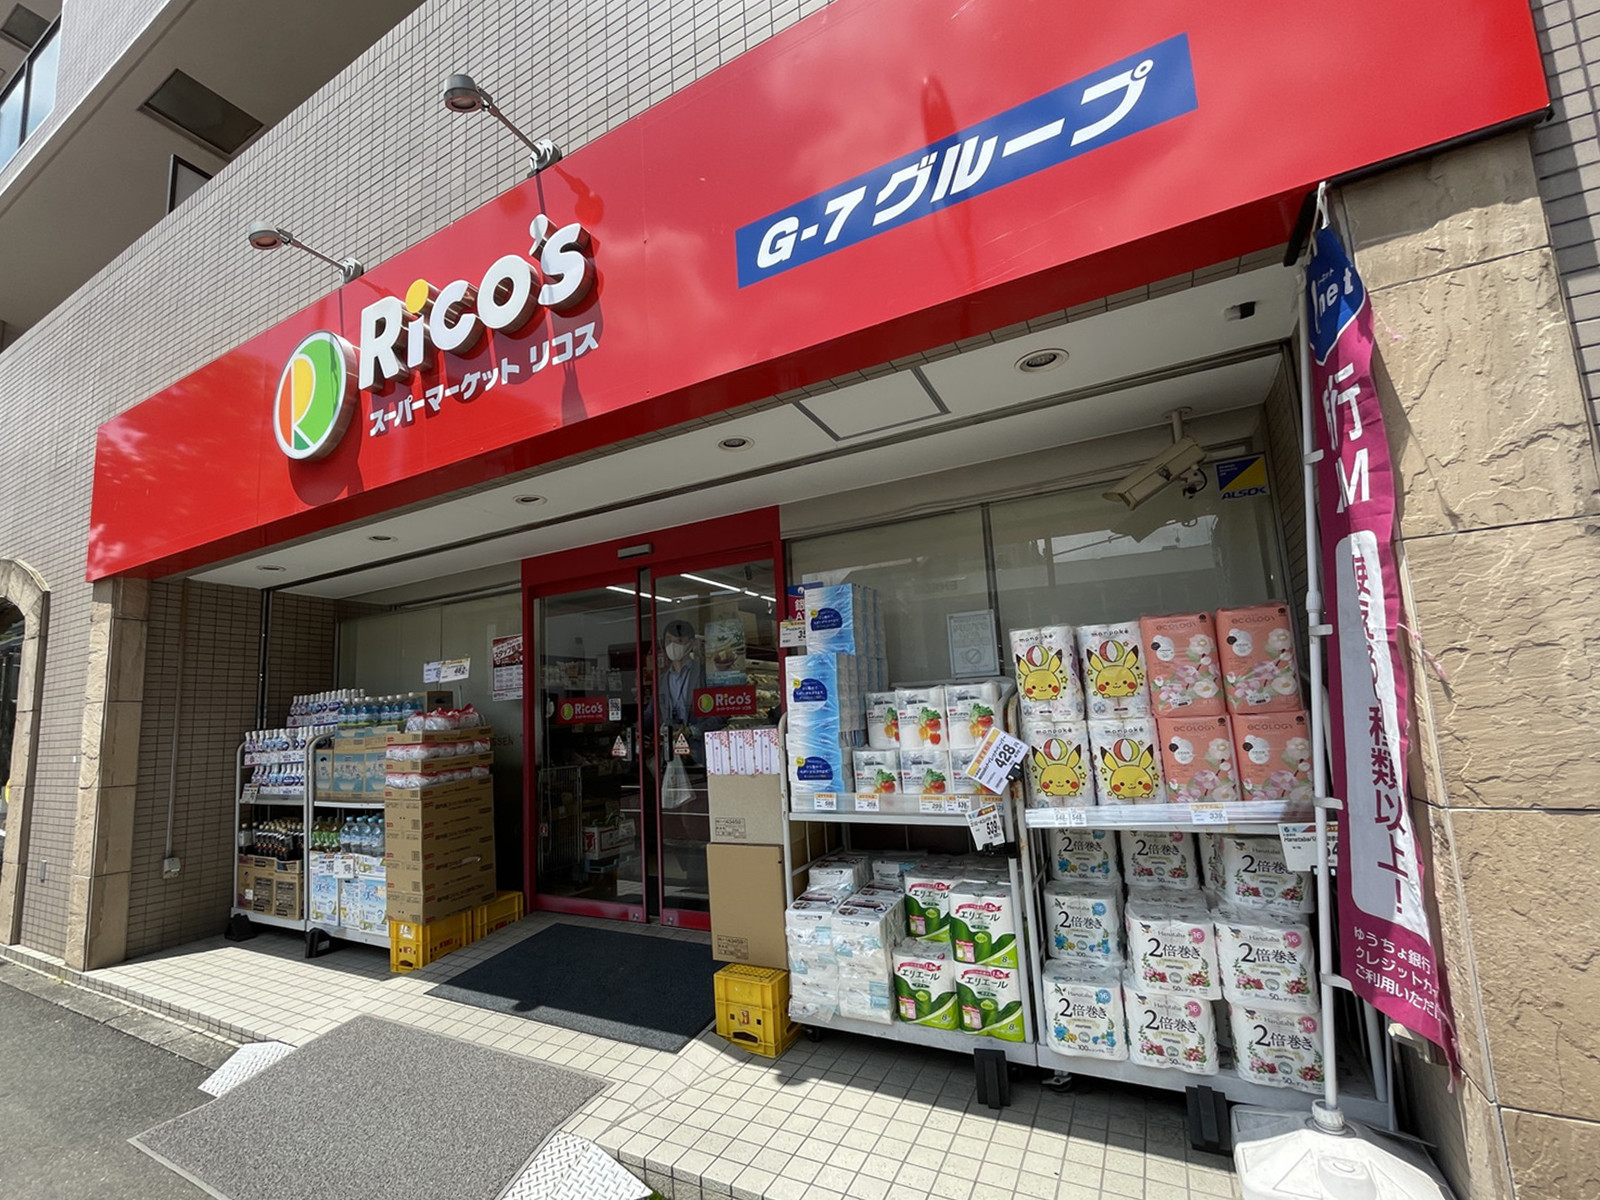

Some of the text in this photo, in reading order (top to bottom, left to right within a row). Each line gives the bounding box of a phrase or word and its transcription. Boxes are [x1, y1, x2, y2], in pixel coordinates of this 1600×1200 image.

[757, 59, 1154, 269] G-7グループ
[358, 213, 590, 391] Rico's
[369, 322, 599, 437] スーパーマーケット リコス
[1221, 486, 1267, 500] ALSOK
[574, 701, 603, 715] Rico's
[714, 691, 752, 707] Rico's
[994, 743, 1016, 769] 428
[1062, 836, 1102, 853] 2倍巻き
[1135, 839, 1180, 856] 2倍巻き
[913, 889, 949, 899] エリエール
[960, 910, 1001, 922] エリエール
[1058, 911, 1103, 930] 2倍巻き
[1147, 937, 1201, 960] 2倍巻き
[1238, 942, 1298, 965] 2倍巻き
[1354, 926, 1432, 975] ゆうちょ銀行
[901, 969, 941, 981] エリエール
[965, 976, 1009, 989] エリエール
[1058, 997, 1107, 1020] 2倍巻き
[1144, 1009, 1197, 1034] 2倍巻き
[1253, 1023, 1313, 1051] 2倍巻き
